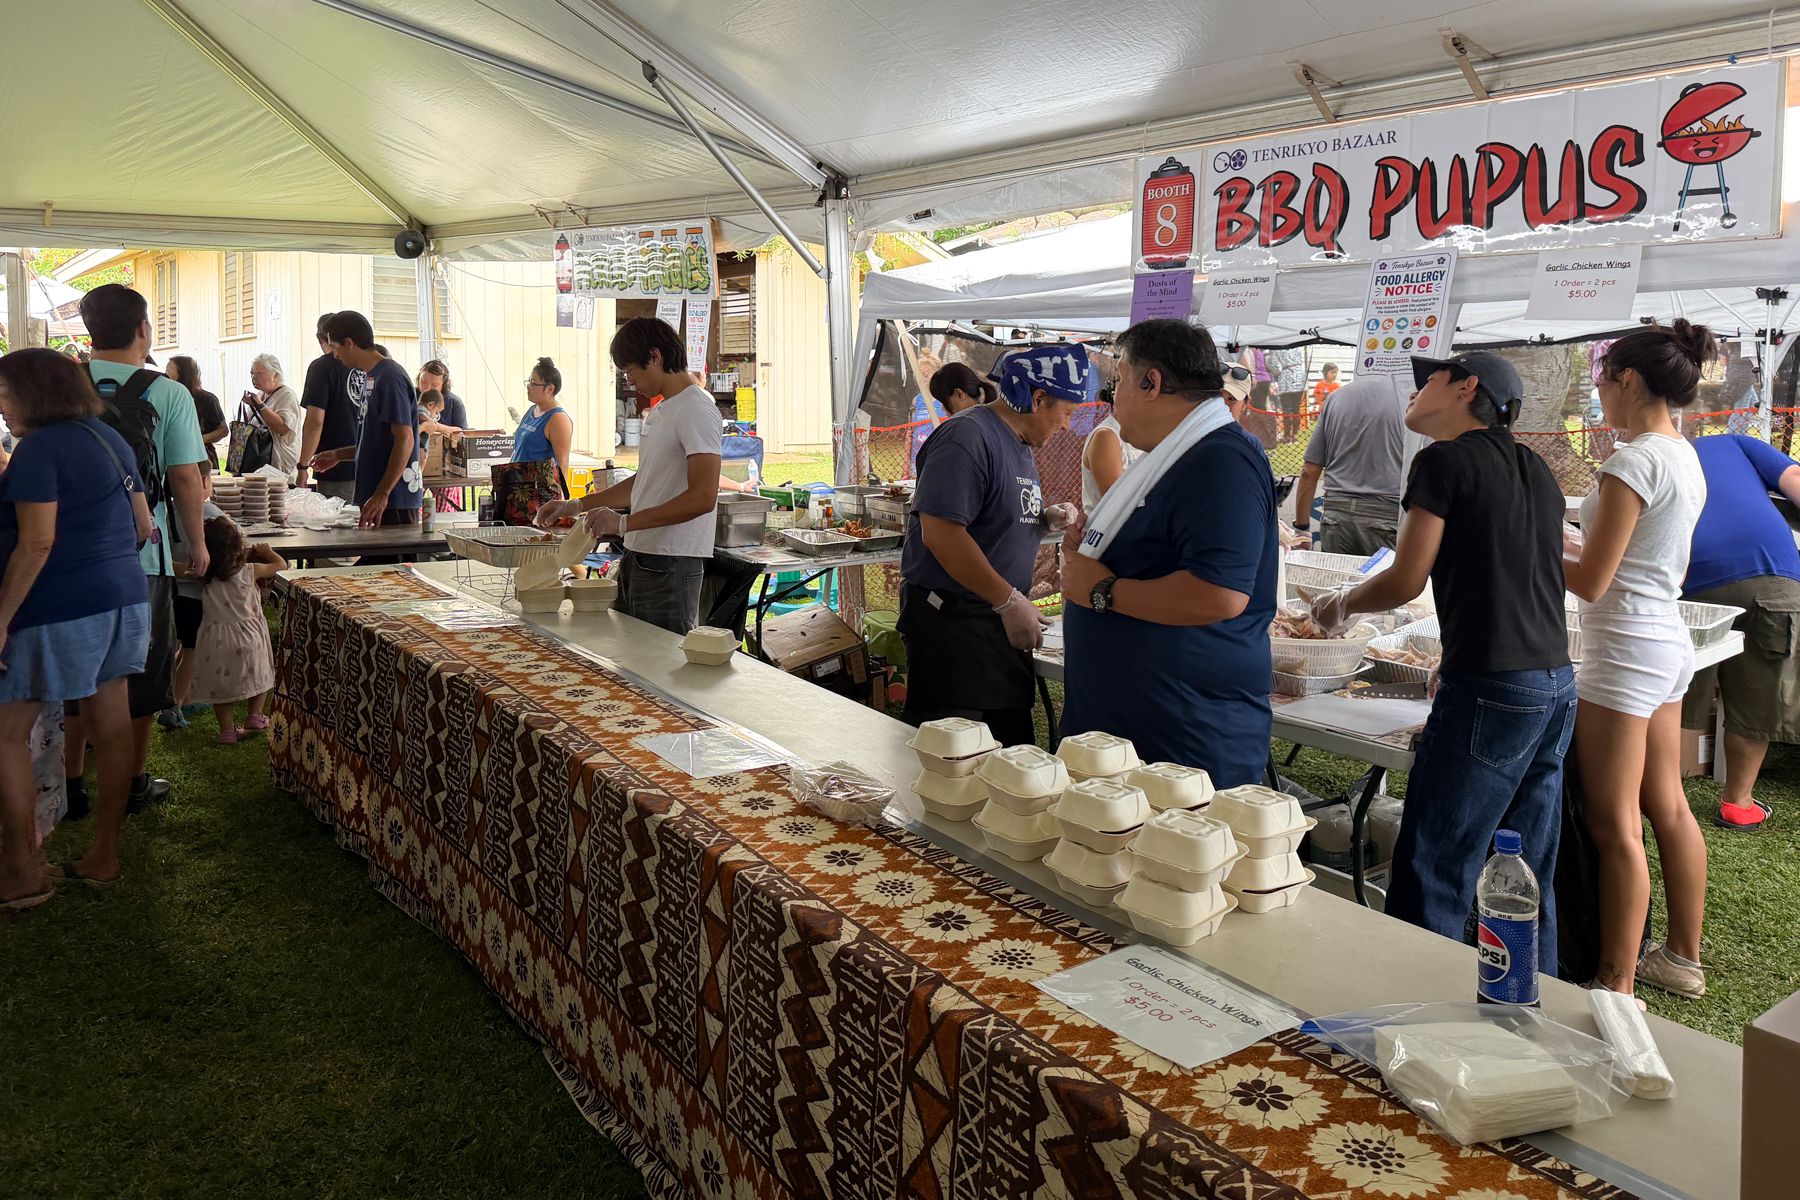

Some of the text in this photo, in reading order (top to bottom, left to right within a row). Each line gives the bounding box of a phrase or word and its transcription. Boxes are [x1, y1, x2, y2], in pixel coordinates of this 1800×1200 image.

[1252, 130, 1397, 163] TENRIKYO BAZAAR
[1147, 184, 1190, 200] BOOTH
[1213, 125, 1647, 258] BBQ PUPUS
[1154, 203, 1178, 247] 8
[1391, 259, 1434, 270] Tenrikyo Bazaar
[1545, 260, 1631, 272] Garlic Chicken Wings
[1148, 278, 1177, 288] Dusts of
[1375, 270, 1446, 286] FOOD ALLERGY
[1561, 279, 1585, 287] Order
[1601, 279, 1616, 287] pcs
[1147, 288, 1177, 297] the Mind
[1384, 283, 1434, 297] NOTICE
[1568, 290, 1597, 299] $5.00
[1227, 300, 1246, 308] $5.00
[475, 438, 516, 447] Honeycrisp
[422, 505, 431, 521] S
[1125, 957, 1263, 1028] Garlic Chicken Wings
[1123, 996, 1174, 1022] $5.00
[1128, 982, 1169, 1003] Order
[1179, 1007, 1193, 1016] 2
[1188, 1015, 1217, 1030] pcs
